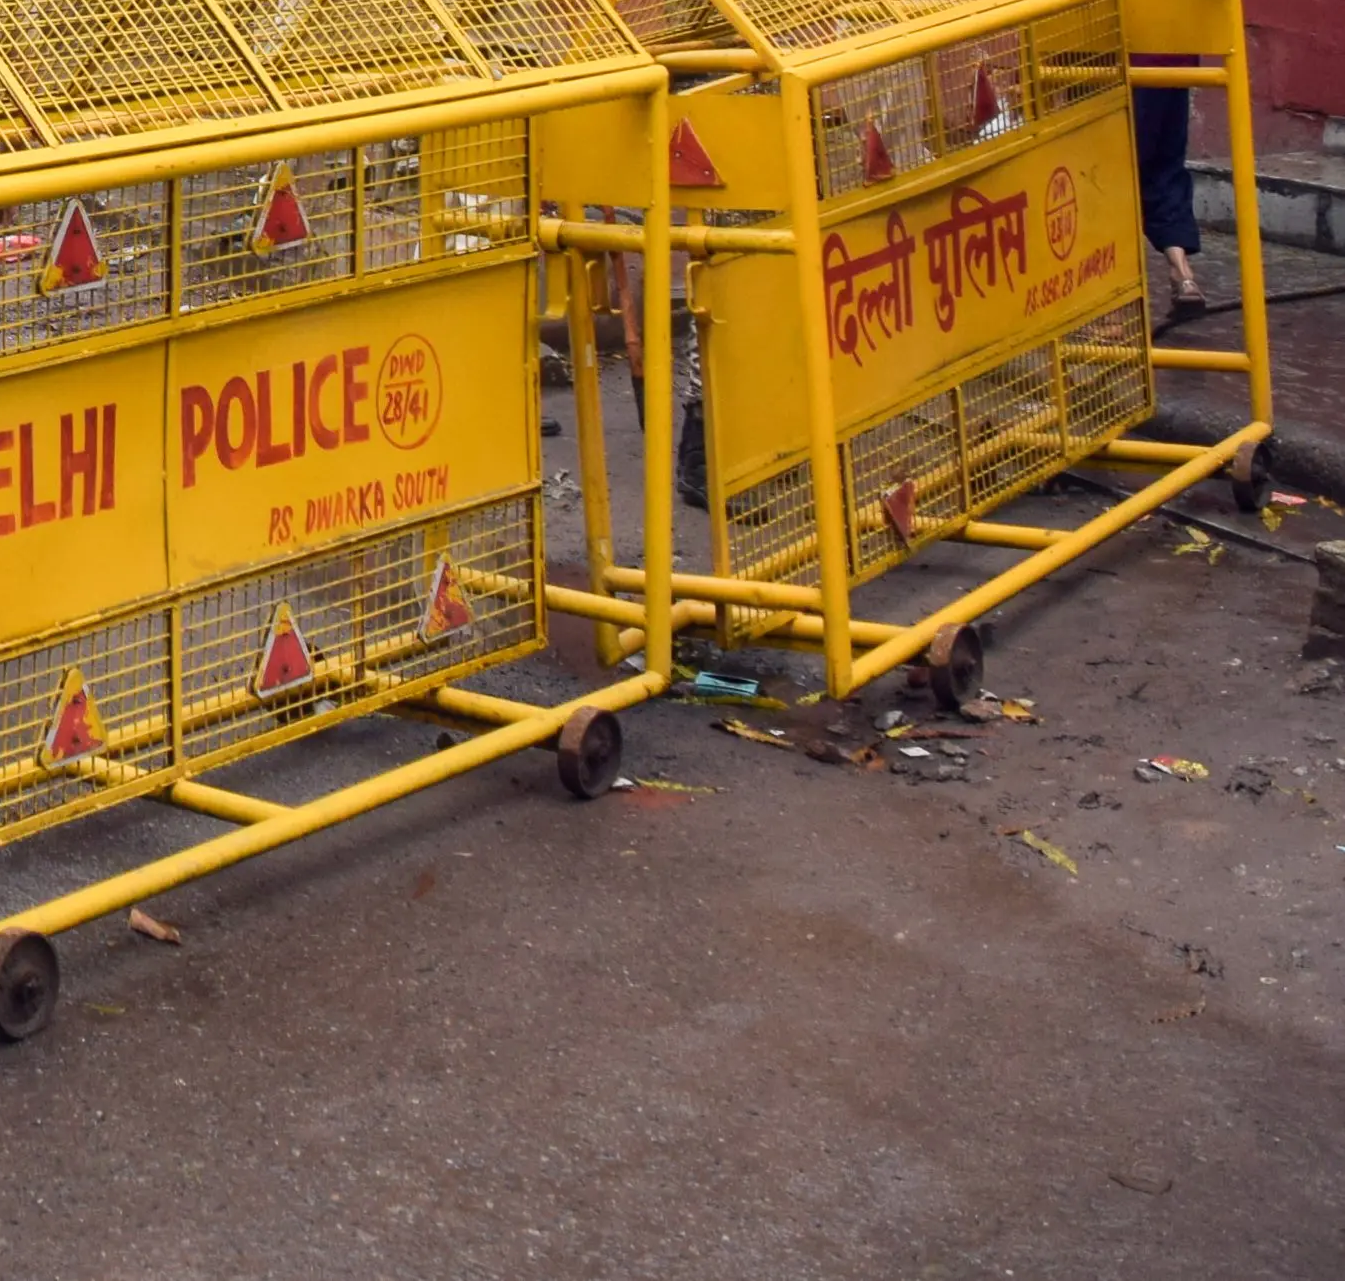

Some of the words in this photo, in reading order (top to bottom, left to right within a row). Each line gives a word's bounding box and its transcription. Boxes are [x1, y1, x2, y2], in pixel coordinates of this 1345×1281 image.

[822, 209, 916, 367] दिल्ली
[923, 184, 1029, 333] पुलिस
[180, 345, 371, 490] POLICE
[390, 352, 425, 380] DWD
[306, 481, 387, 534] DWARKA
[393, 465, 450, 511] SOUTH
